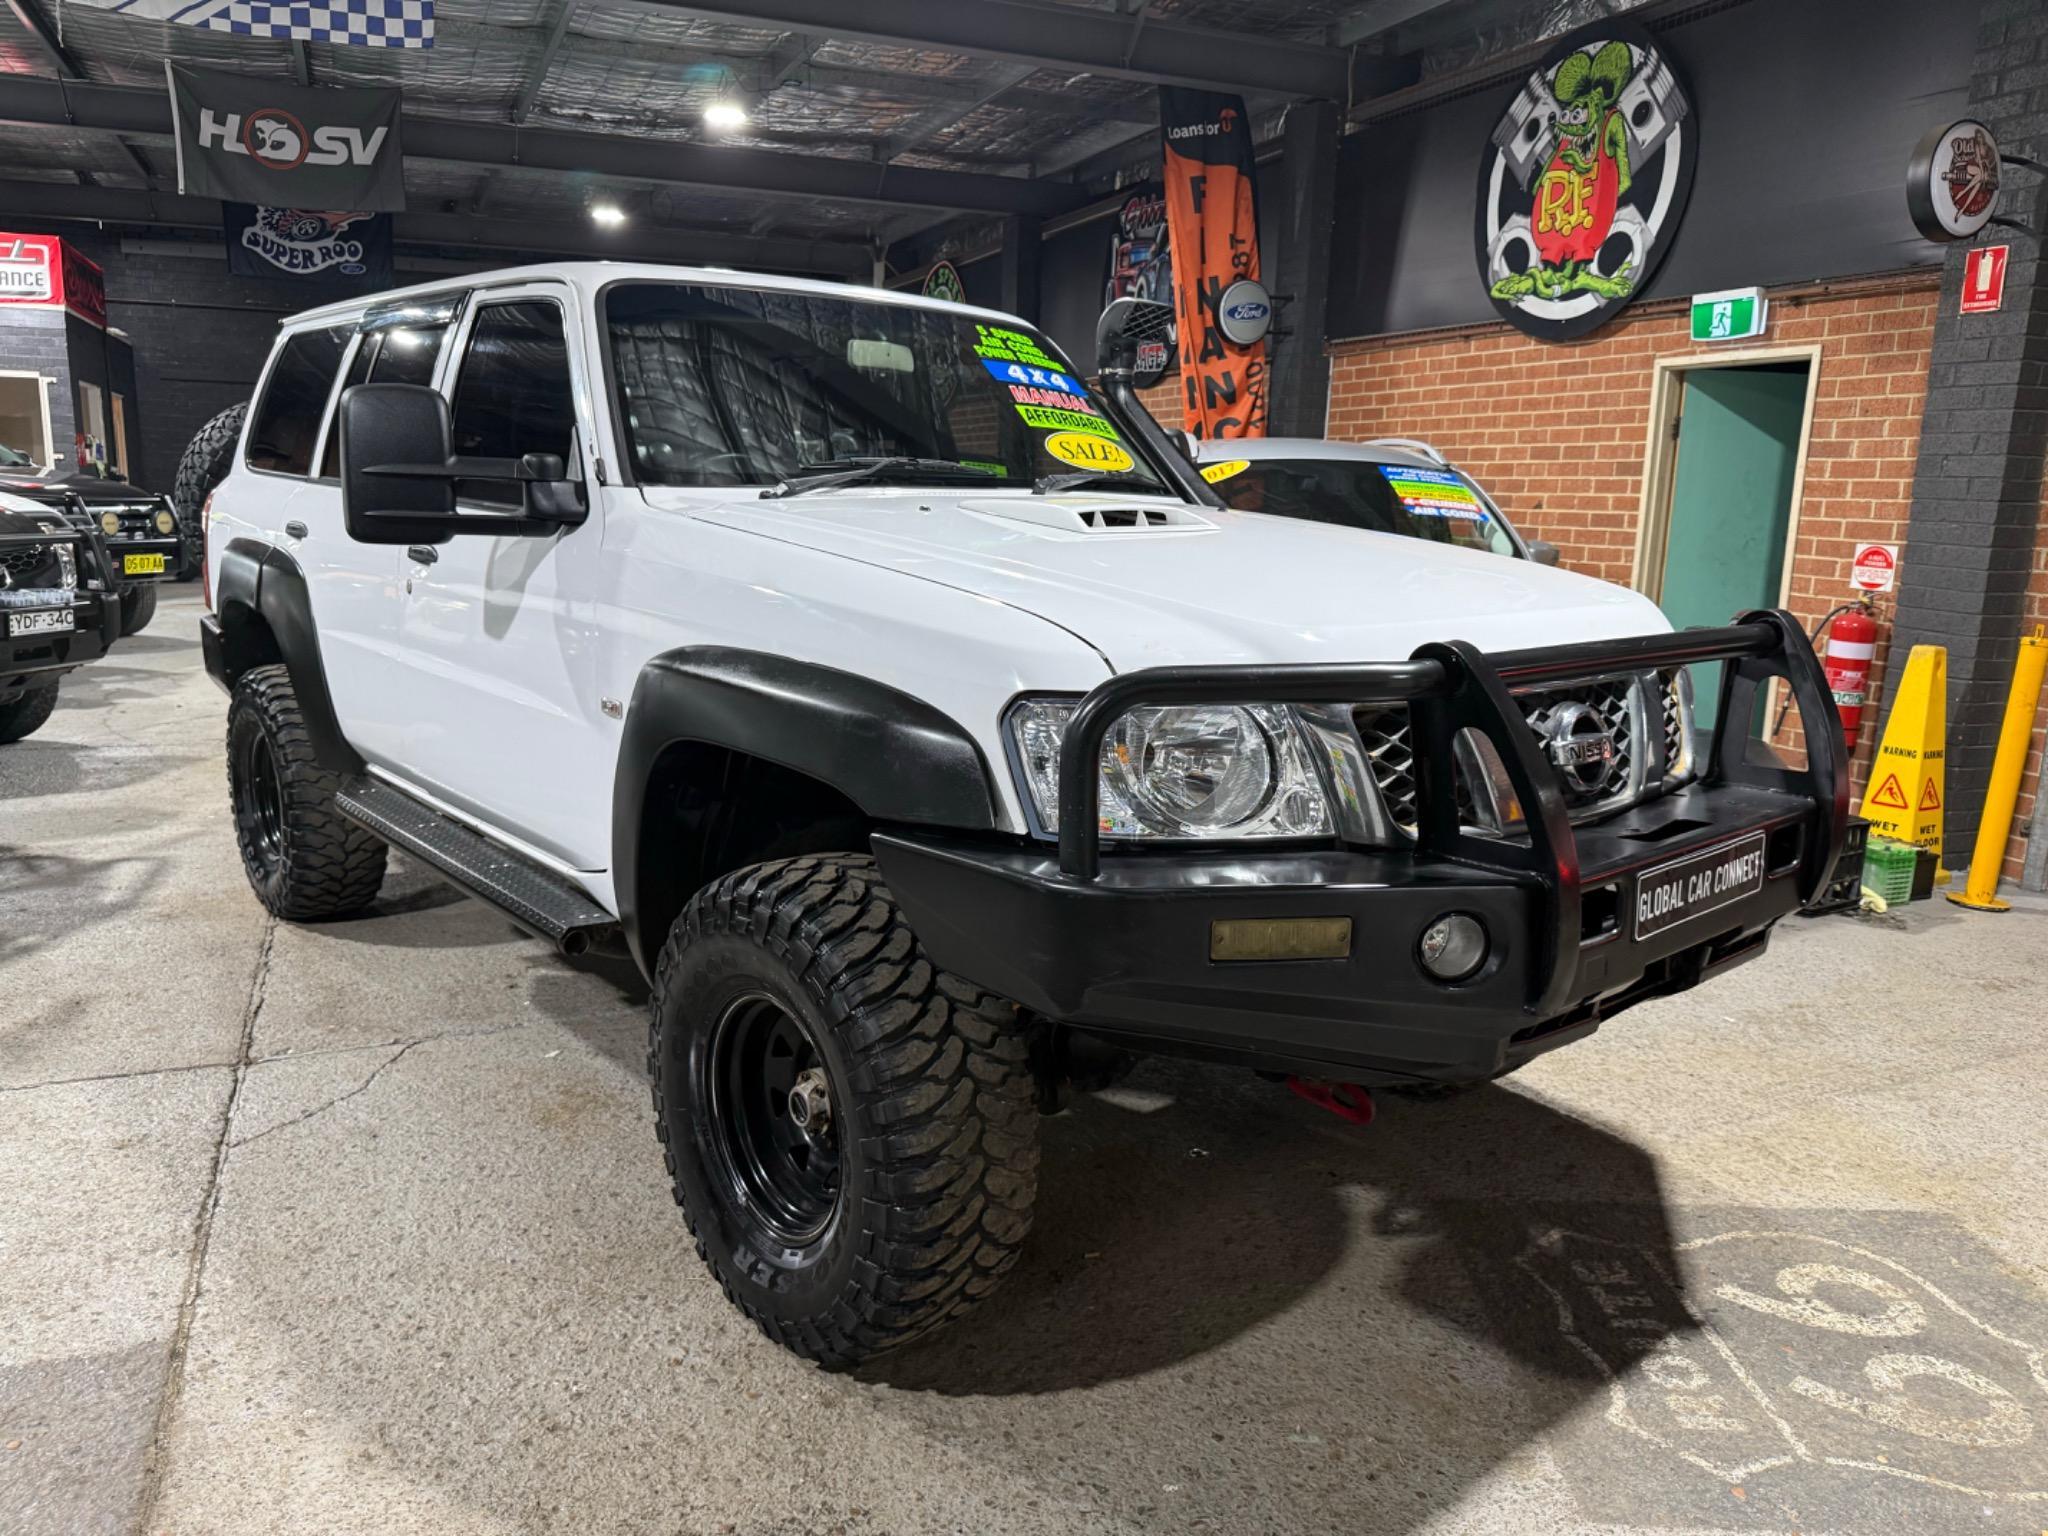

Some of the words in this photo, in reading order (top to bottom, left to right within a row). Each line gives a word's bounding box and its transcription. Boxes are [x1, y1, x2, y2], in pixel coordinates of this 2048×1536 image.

[247, 232, 317, 270] SUPER
[319, 241, 361, 262] ROO
[0, 271, 44, 287] ANCE
[1233, 304, 1264, 319] Ford
[1009, 385, 1098, 415] MANUAL
[1024, 408, 1112, 434] AFFORDABLE
[1059, 441, 1124, 464] SALE!
[1206, 463, 1234, 480] 017
[1884, 745, 1917, 759] WARNING
[1923, 749, 1944, 760] WARNING
[1871, 820, 1899, 832] WET
[1920, 824, 1936, 835] WET
[1639, 879, 1684, 922] GLOBAL
[1688, 871, 1711, 904] CAR
[1714, 850, 1761, 894] CONNECT
